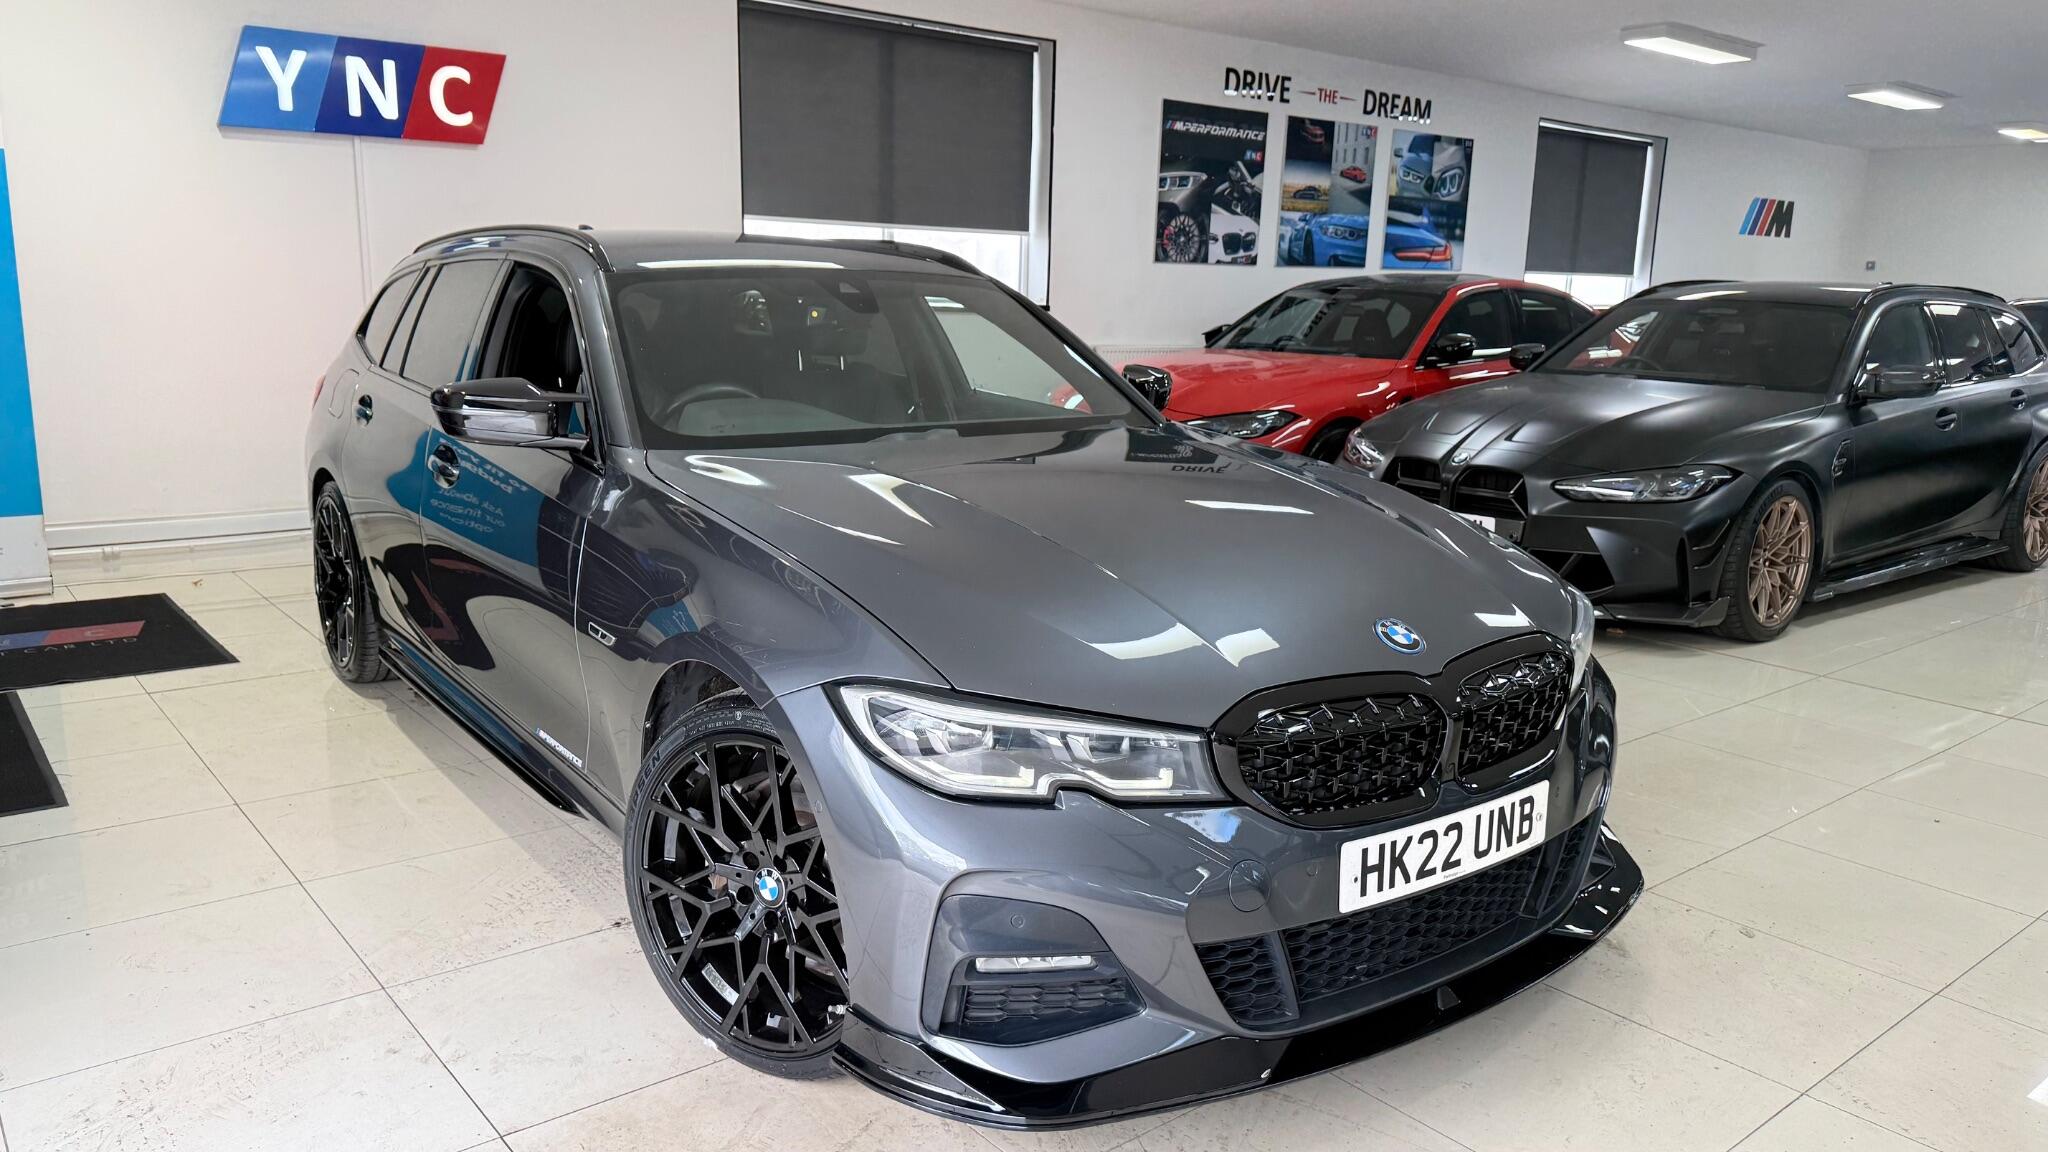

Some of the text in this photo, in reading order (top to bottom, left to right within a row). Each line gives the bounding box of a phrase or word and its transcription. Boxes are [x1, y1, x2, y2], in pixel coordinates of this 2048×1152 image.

[255, 46, 474, 127] YNC
[1224, 66, 1432, 124] DRIVE THE DREAM
[1359, 795, 1535, 898] HK22 UNB
